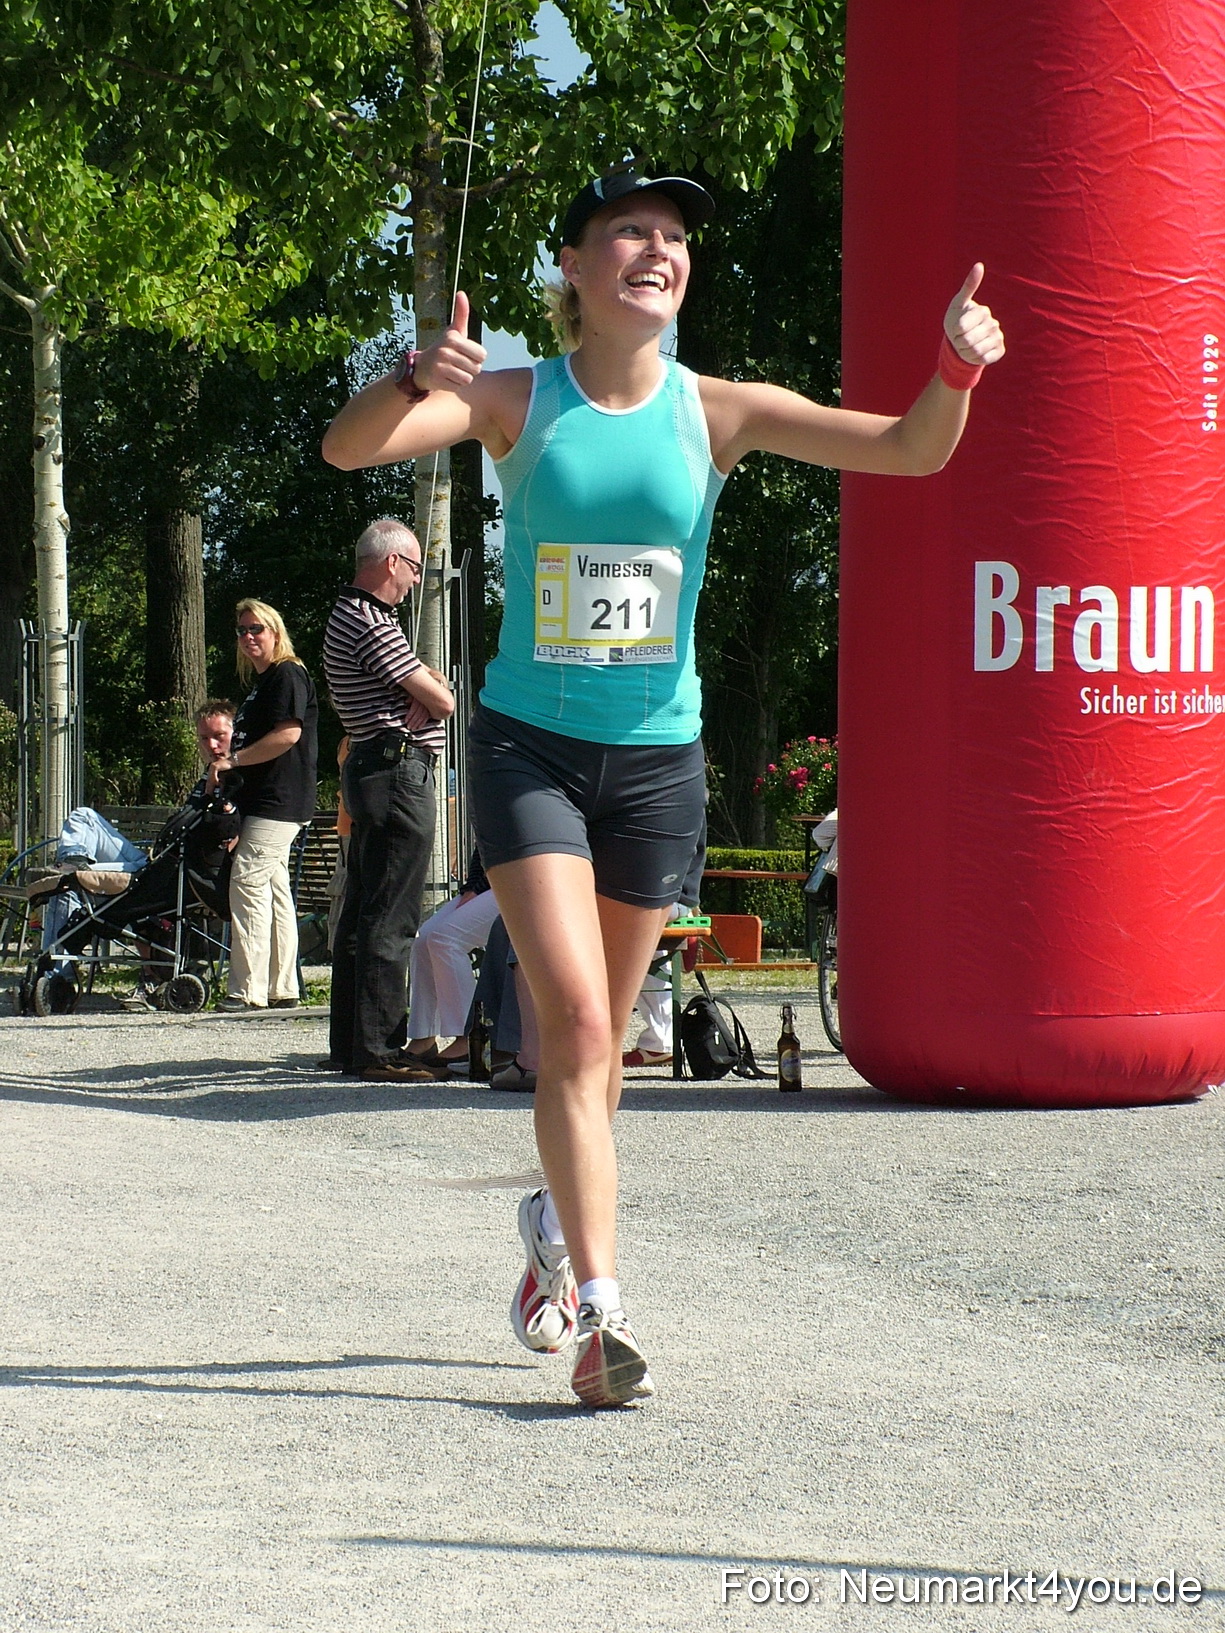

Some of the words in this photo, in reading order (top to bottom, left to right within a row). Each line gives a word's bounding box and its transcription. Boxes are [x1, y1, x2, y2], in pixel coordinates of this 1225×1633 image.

[1202, 333, 1219, 384] 1929
[1201, 393, 1218, 432] Seit
[576, 554, 653, 578] Vanessa
[542, 589, 551, 606] D
[590, 597, 651, 630] 211
[973, 560, 1215, 673] Braun
[536, 644, 591, 659] BOCK
[624, 645, 674, 656] PFLEIDERER
[1080, 684, 1148, 715] Sicher
[1154, 688, 1177, 714] ist
